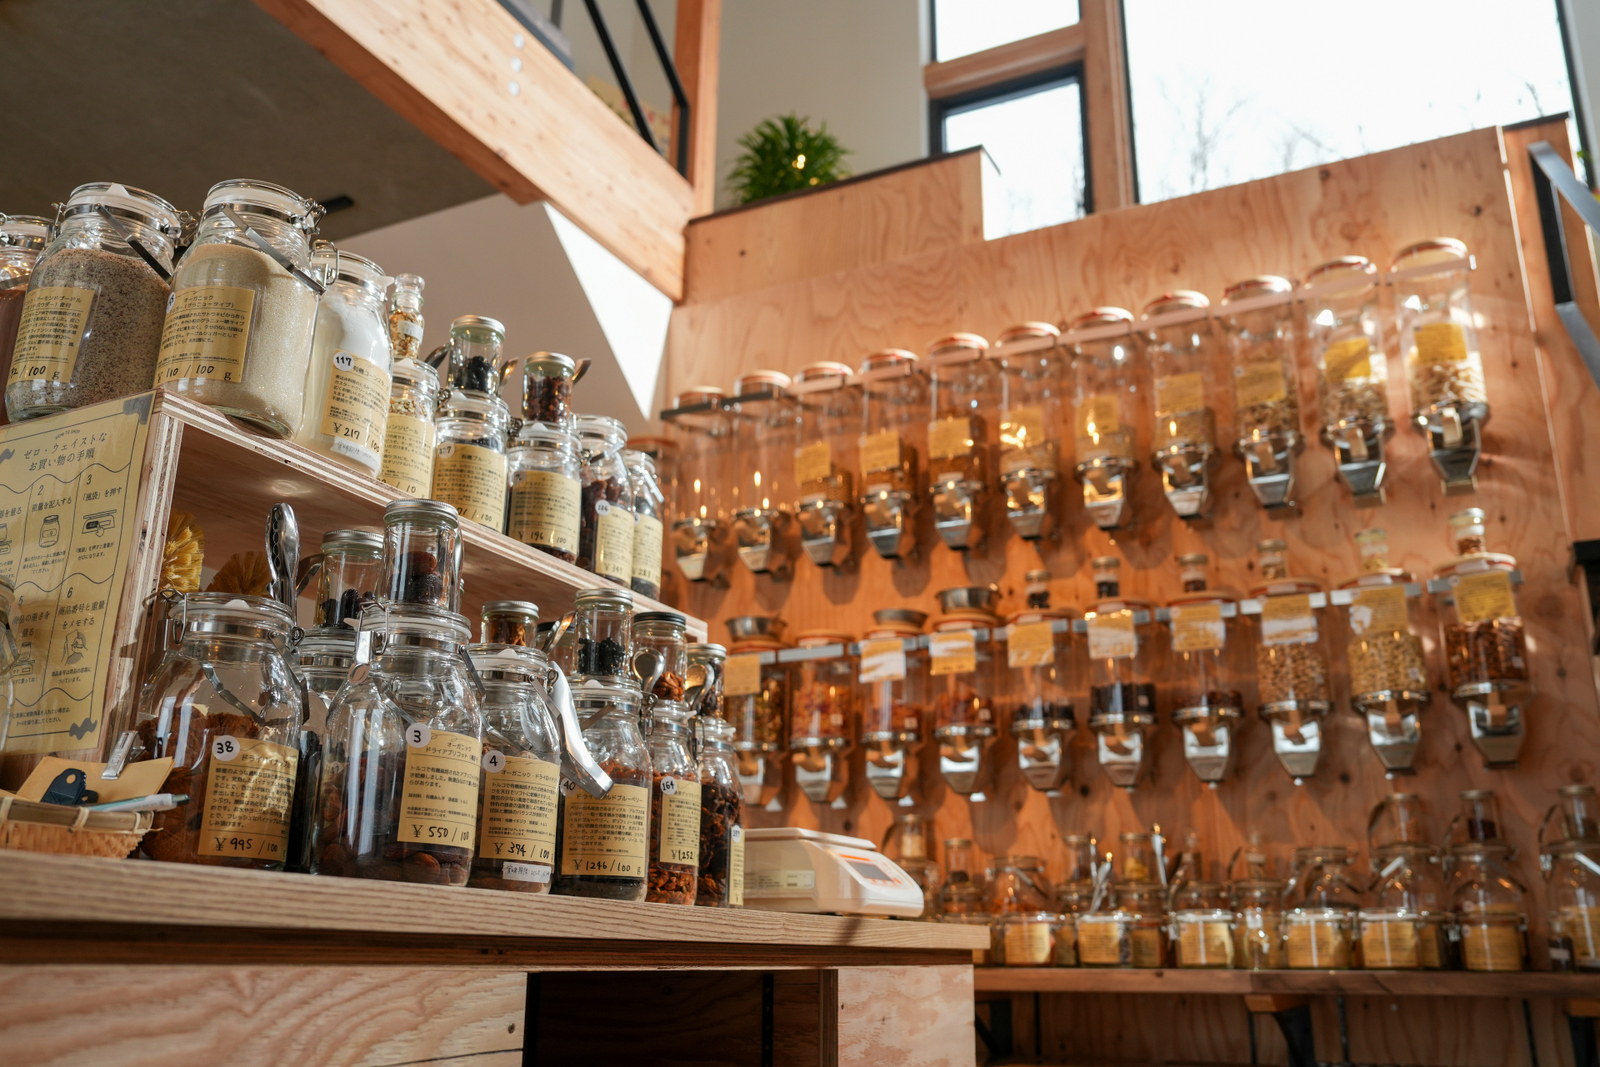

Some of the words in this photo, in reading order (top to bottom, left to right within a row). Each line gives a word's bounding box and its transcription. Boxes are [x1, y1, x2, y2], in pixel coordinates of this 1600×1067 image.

[336, 356, 352, 366] 117
[28, 366, 46, 376] 100
[52, 370, 60, 380] g
[166, 368, 178, 378] 110
[196, 364, 214, 374] 100
[224, 372, 232, 381] g
[344, 427, 360, 440] 217
[24, 432, 108, 460] ゼロ・ウェイストな
[28, 448, 96, 472] お買い物の手順
[462, 454, 492, 464] 有機プルーン
[86, 474, 92, 485] 3
[38, 484, 44, 496] 2
[32, 496, 72, 512] 重量を記入する
[530, 531, 544, 541] 196
[67, 587, 73, 598] 6
[18, 596, 24, 606] 5
[58, 600, 106, 616] 商品番号と重量
[62, 617, 95, 629] をメモする
[413, 730, 421, 743] 3
[216, 740, 234, 754] 38
[426, 746, 468, 758] ドライアプリコット
[447, 742, 472, 752] オーガニック
[489, 755, 498, 766] 4
[563, 780, 576, 791] 40
[662, 780, 674, 791] 164
[576, 793, 642, 803] ドライルドブルーベリー
[412, 824, 423, 838] ¥
[428, 826, 448, 838] 550
[214, 837, 227, 852] ¥
[230, 837, 253, 850] 995
[493, 842, 504, 855] ¥
[678, 850, 693, 861] 1,252
[573, 859, 582, 870] ¥
[586, 861, 607, 871] 1246
[617, 862, 631, 872] 100
